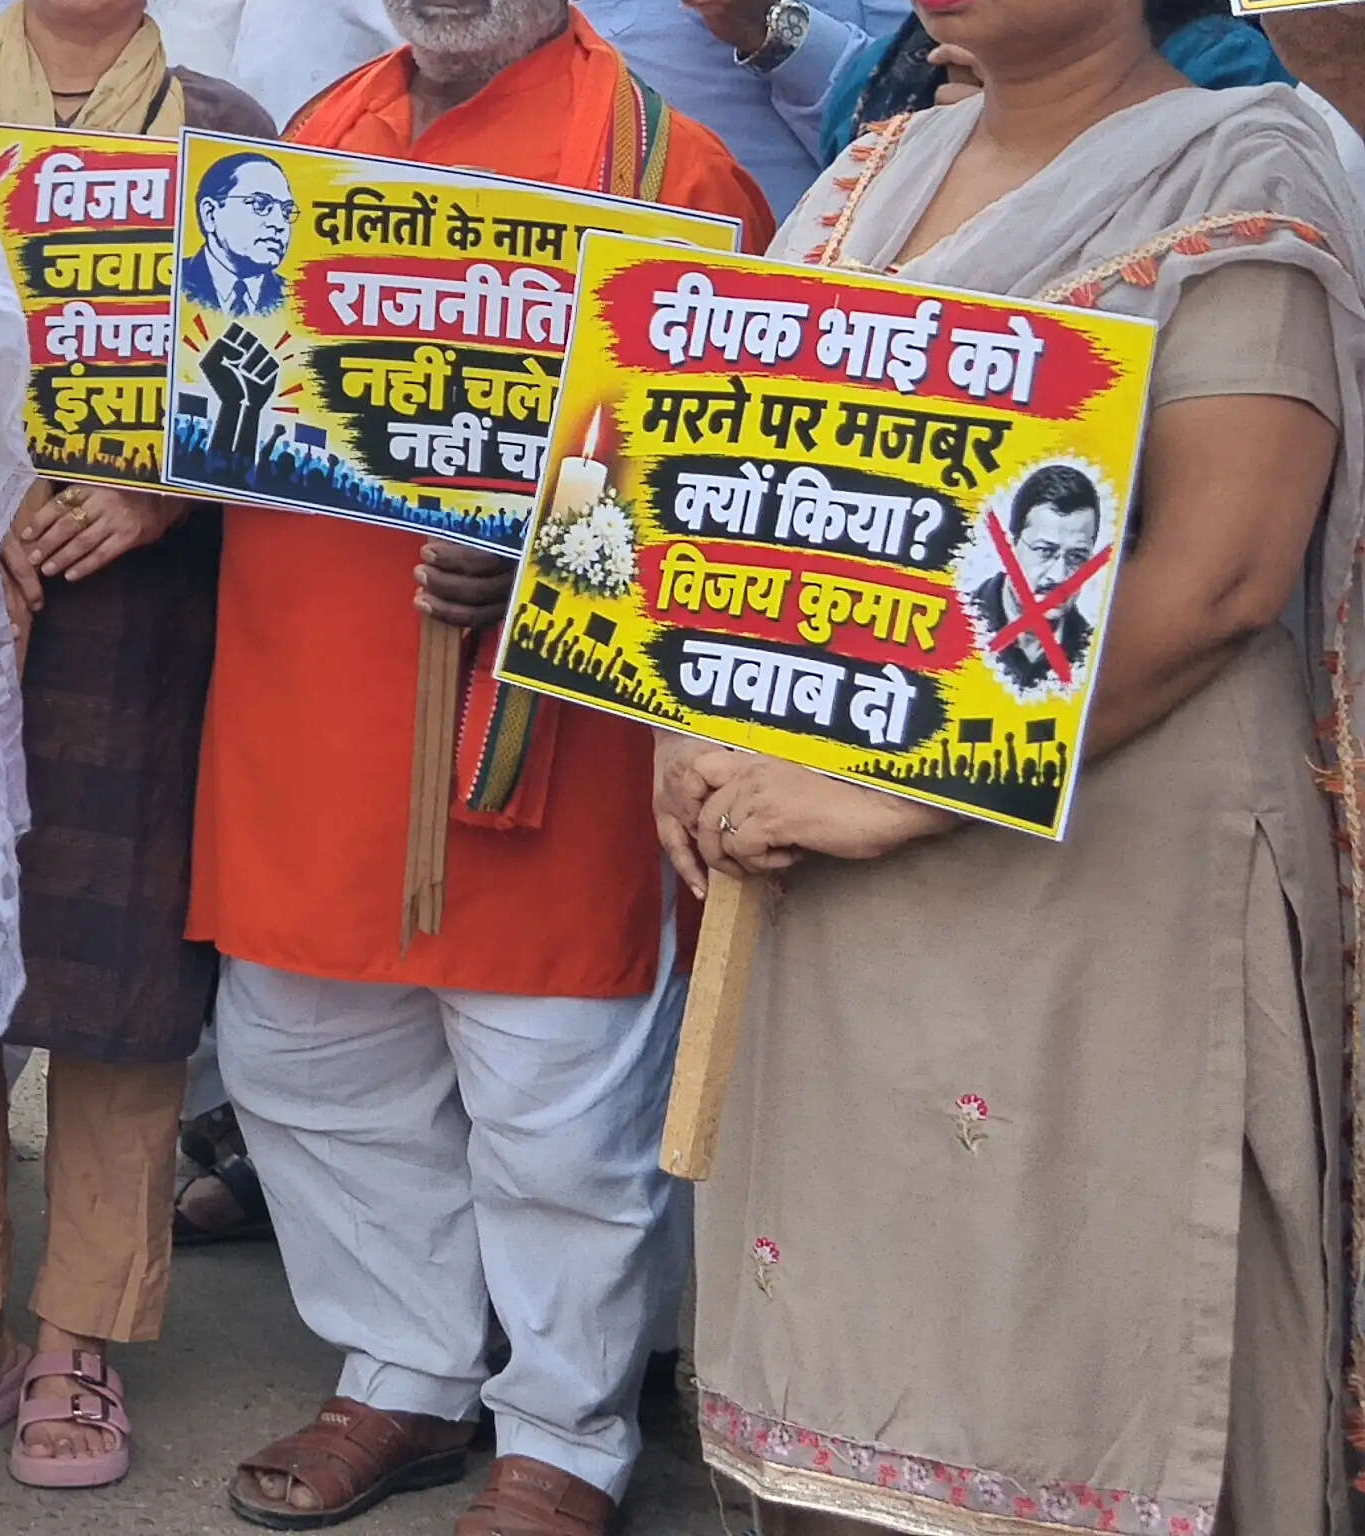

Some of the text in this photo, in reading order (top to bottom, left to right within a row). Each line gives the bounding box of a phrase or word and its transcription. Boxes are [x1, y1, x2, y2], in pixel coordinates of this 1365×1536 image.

[34, 152, 170, 224] विजय
[312, 186, 439, 248] दलितों
[446, 202, 485, 251] के
[492, 216, 568, 261] नाम
[326, 263, 575, 346] राजनीति
[649, 271, 1045, 406] दीपक भाई को
[51, 362, 167, 434] इंसा
[340, 345, 457, 416] नहीं
[387, 411, 493, 478] नहीं
[643, 375, 1015, 488] मरने पर मजबूर
[673, 460, 946, 561] क्यों किया?
[656, 543, 949, 651] विजय कुमार
[679, 639, 918, 748] जवाब दो
